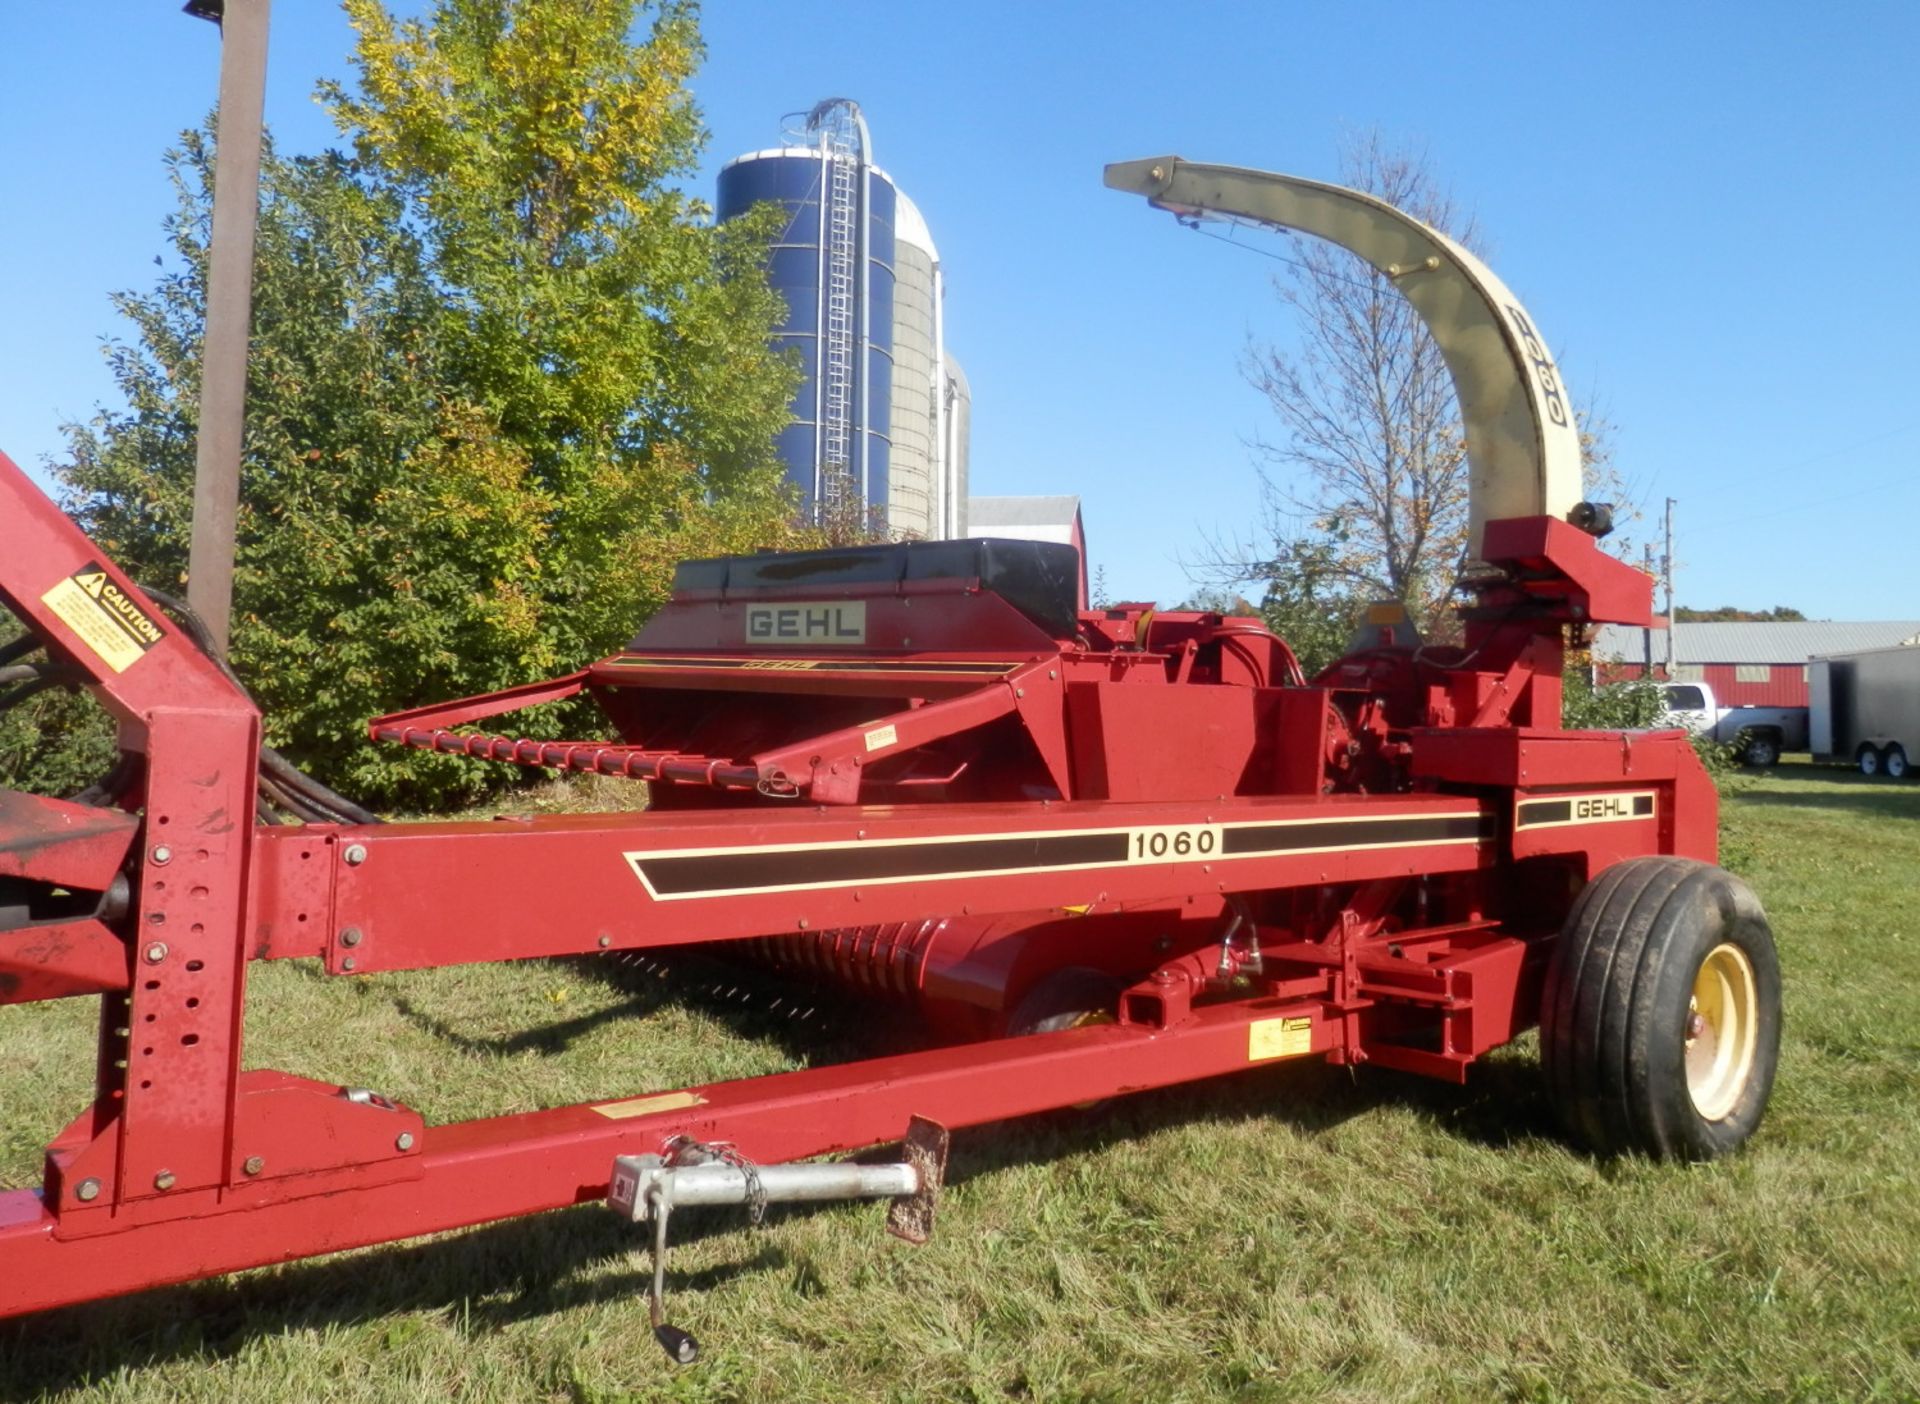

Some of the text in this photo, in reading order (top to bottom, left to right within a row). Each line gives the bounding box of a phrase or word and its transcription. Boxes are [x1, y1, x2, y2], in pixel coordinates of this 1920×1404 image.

[103, 584, 162, 642] CAUTION
[750, 608, 860, 637] GEHL
[743, 661, 809, 669] GEHL
[1577, 799, 1627, 818] GEHL
[1136, 830, 1214, 857] 1060
